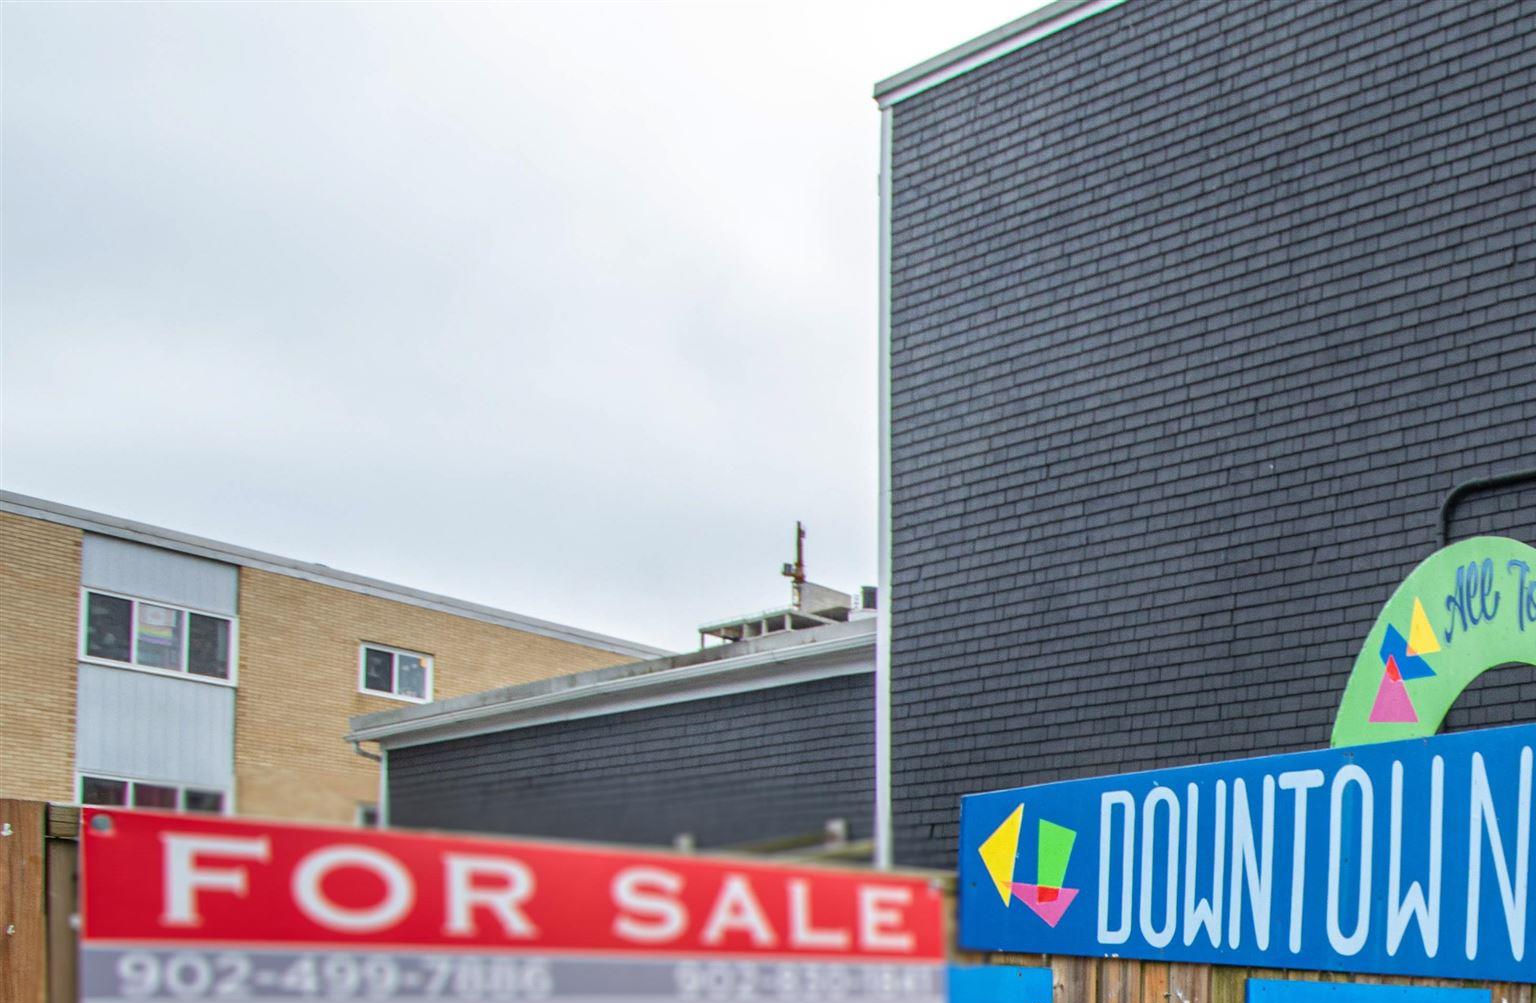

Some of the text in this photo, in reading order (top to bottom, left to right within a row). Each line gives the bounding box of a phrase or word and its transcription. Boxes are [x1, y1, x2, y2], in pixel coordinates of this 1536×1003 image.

[1445, 558, 1500, 643] All
[160, 834, 915, 949] FOR SALE
[1097, 746, 1533, 961] DOWNTOWN
